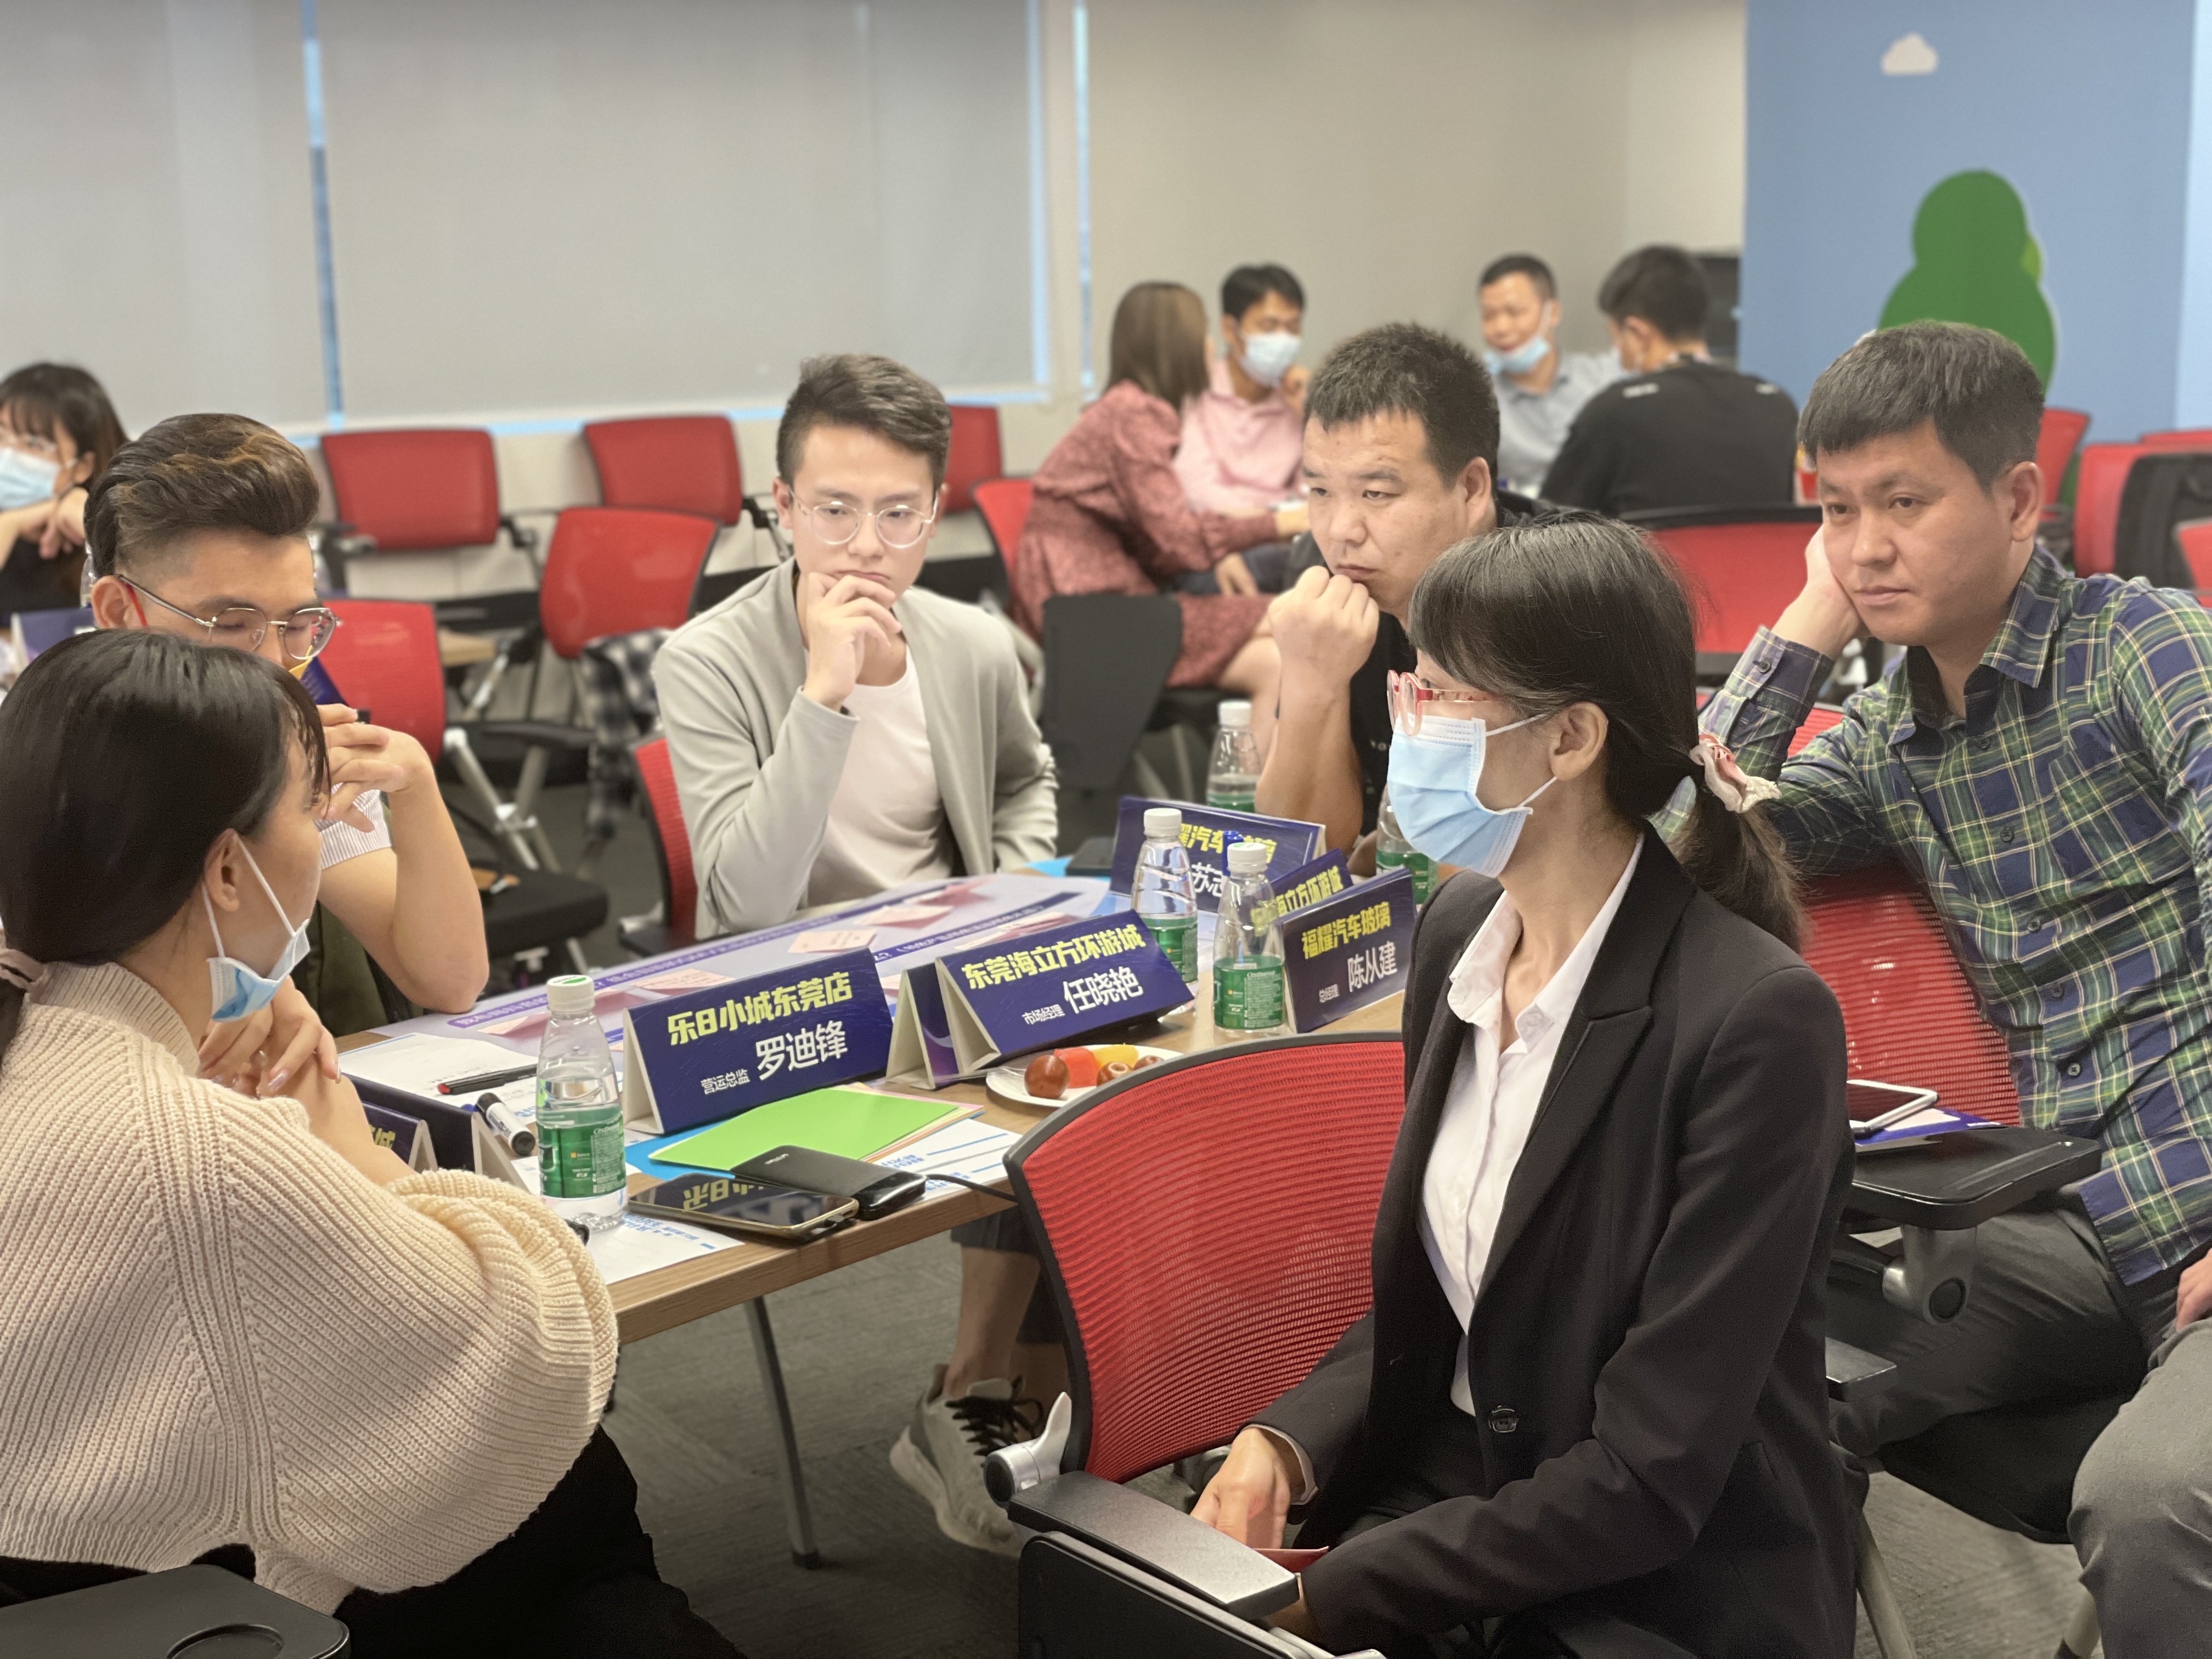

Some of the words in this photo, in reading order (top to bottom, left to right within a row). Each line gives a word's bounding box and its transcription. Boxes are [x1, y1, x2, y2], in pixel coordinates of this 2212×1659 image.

[961, 924, 1146, 989] 东莞海立方环游城
[1301, 901, 1391, 959] 福耀汽车玻璃
[1063, 966, 1144, 1014] 任晓艳
[1347, 940, 1397, 992] 陈从建
[668, 972, 852, 1045] 乐日小城东莞店
[1022, 1004, 1065, 1025] 市场经理
[755, 1020, 848, 1081] 罗迪锋
[701, 1068, 750, 1094] 营运总监
